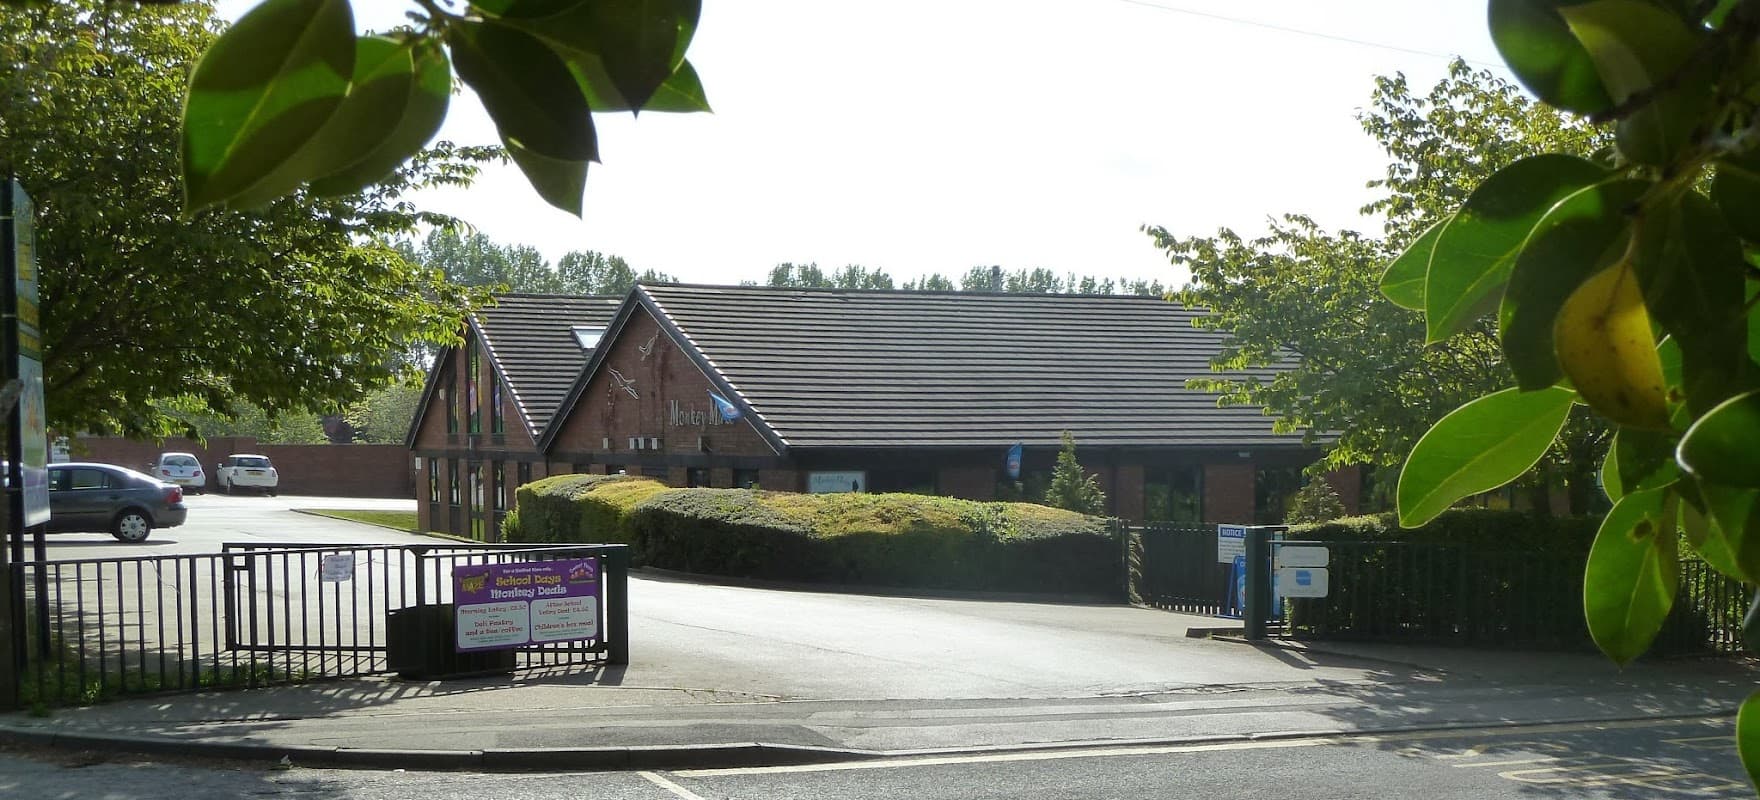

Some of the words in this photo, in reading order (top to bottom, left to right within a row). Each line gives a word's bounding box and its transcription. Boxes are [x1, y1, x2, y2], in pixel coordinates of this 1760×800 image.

[670, 399, 706, 431] Monkey
[1222, 529, 1242, 537] NOTICE
[495, 576, 531, 586] School
[535, 574, 561, 585] Days
[490, 587, 535, 599] Monkey
[538, 585, 567, 596] Deals
[489, 619, 514, 627] Pastry
[534, 622, 564, 631] Children's
[465, 628, 478, 636] and
